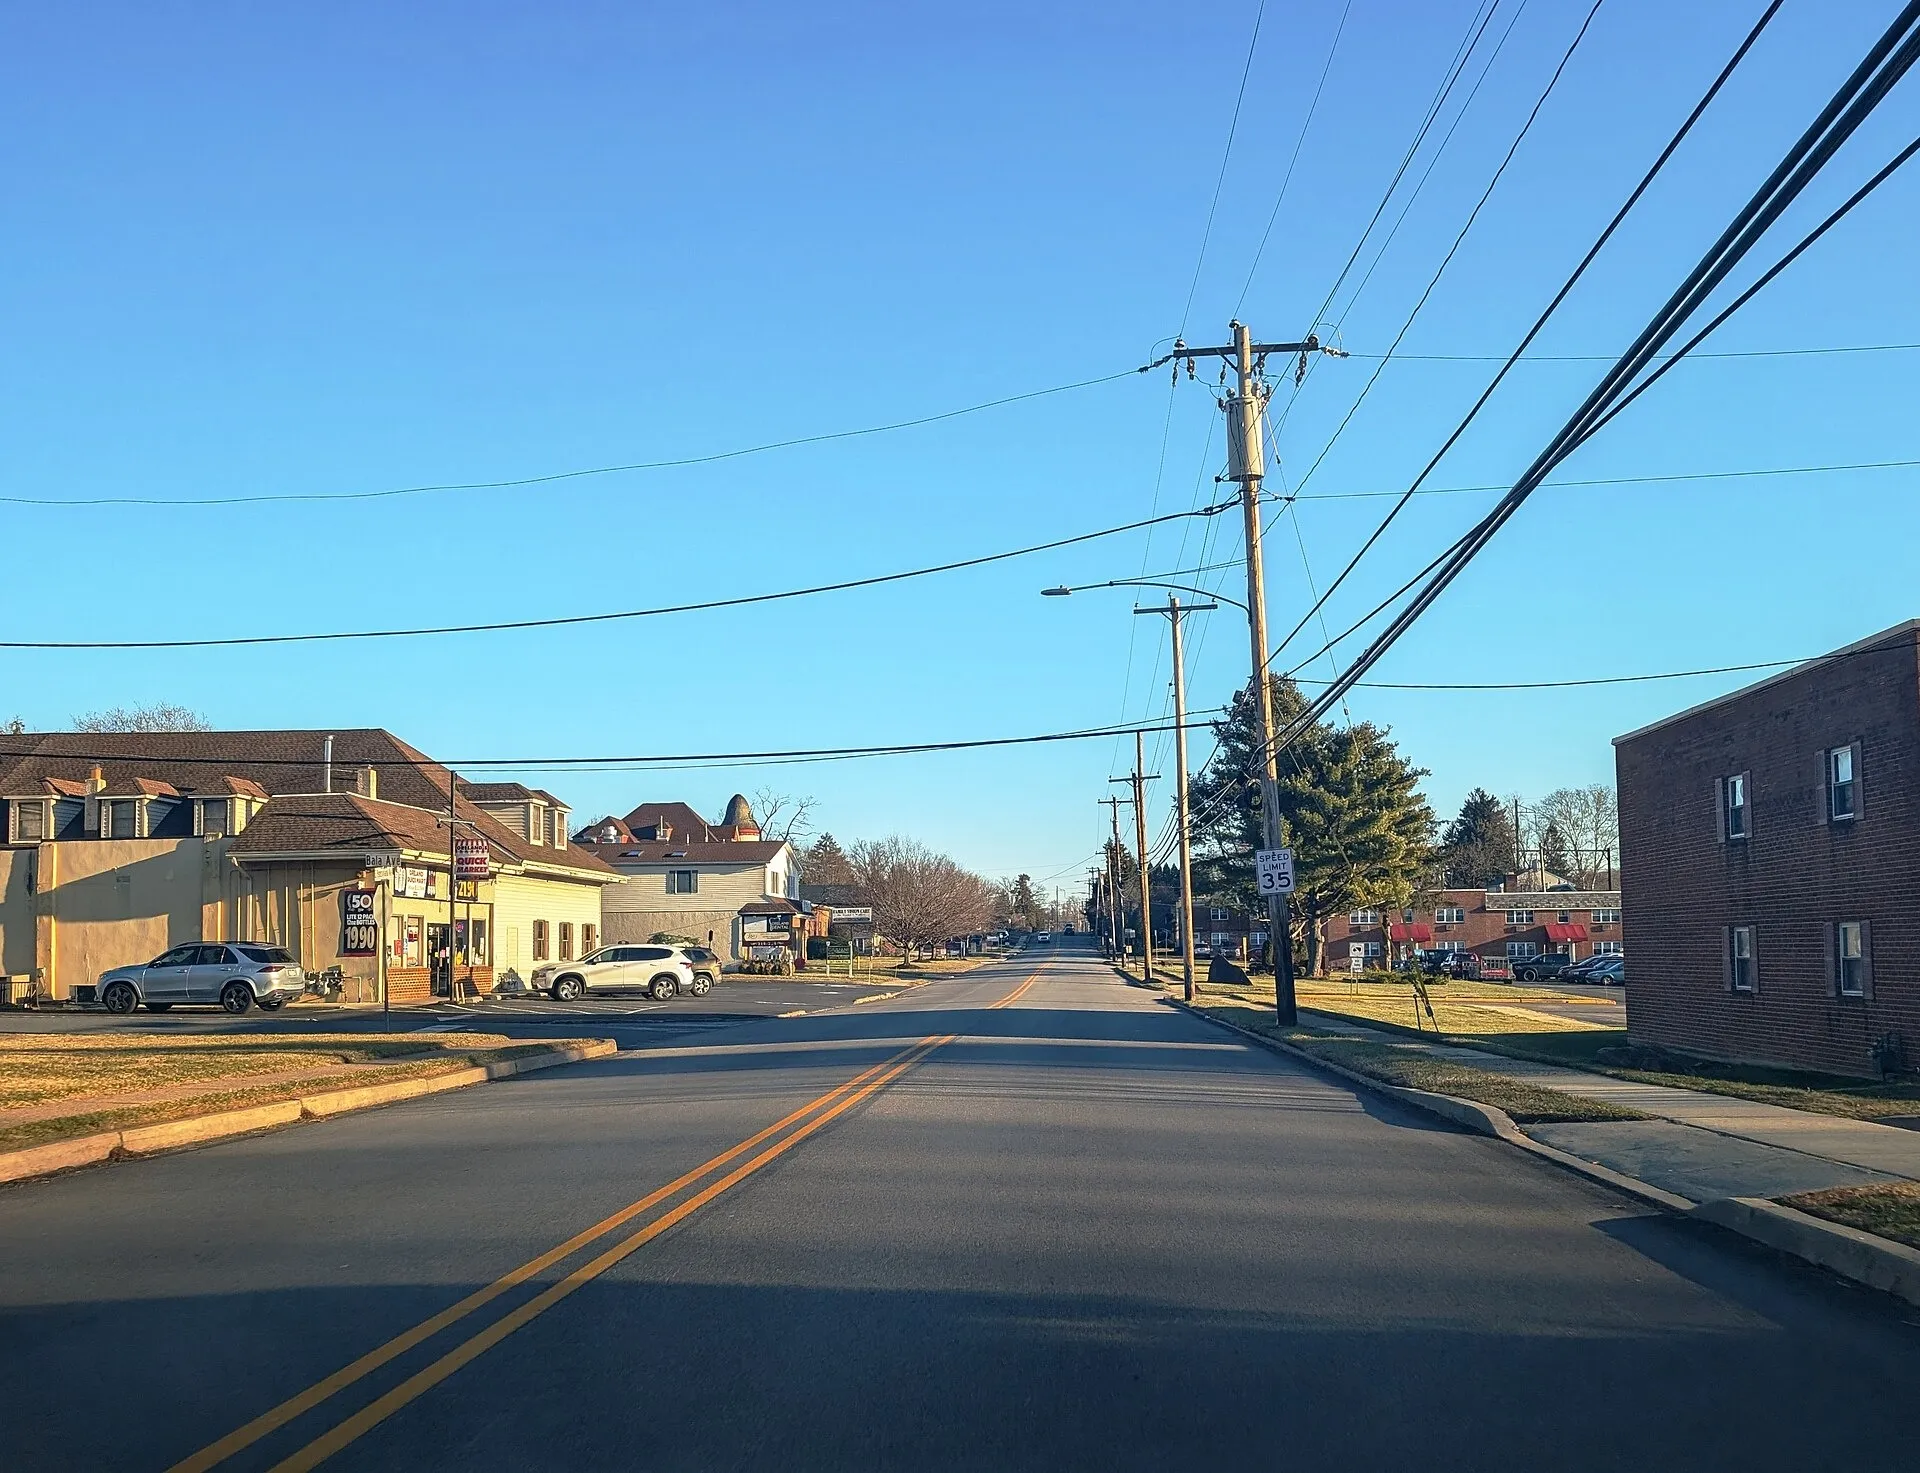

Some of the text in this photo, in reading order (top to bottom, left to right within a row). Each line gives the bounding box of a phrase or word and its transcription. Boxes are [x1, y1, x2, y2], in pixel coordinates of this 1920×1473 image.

[366, 855, 401, 866] Bala Ave
[457, 857, 488, 865] QUICK
[1259, 853, 1290, 863] SPEED
[1263, 862, 1287, 871] LIMIT
[1262, 871, 1291, 890] 35
[345, 926, 375, 949] 19.90
